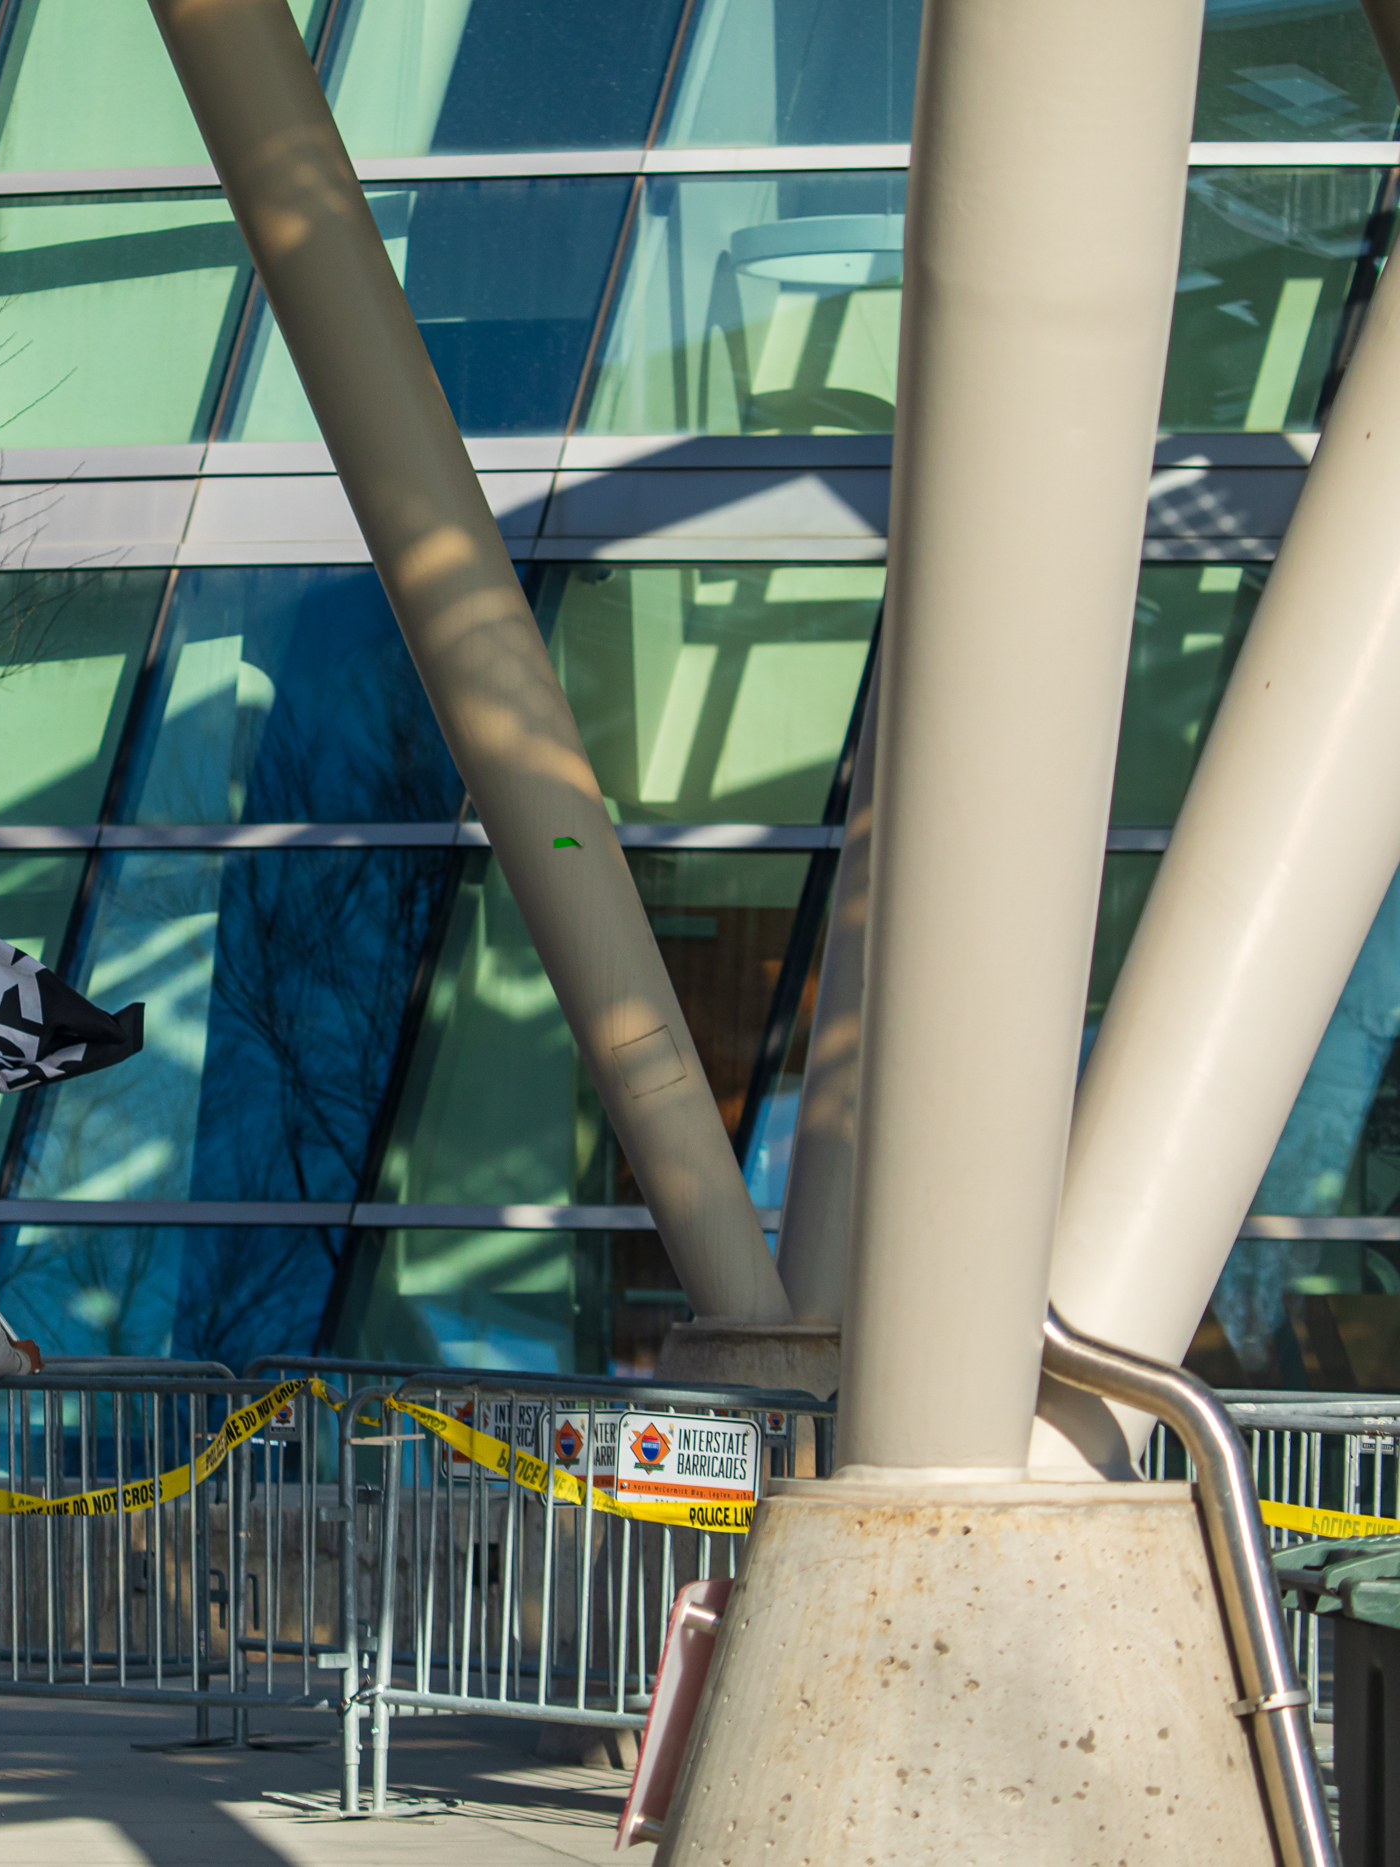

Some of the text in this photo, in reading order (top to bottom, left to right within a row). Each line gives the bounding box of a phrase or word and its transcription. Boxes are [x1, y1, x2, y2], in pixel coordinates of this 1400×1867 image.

[239, 1411, 257, 1432] DO
[256, 1397, 274, 1421] NOT
[678, 1428, 748, 1456] INTERSTATE
[677, 1453, 747, 1480] BARRICADES
[73, 1498, 89, 1515] DO
[689, 1507, 753, 1527] POLICE LIN
